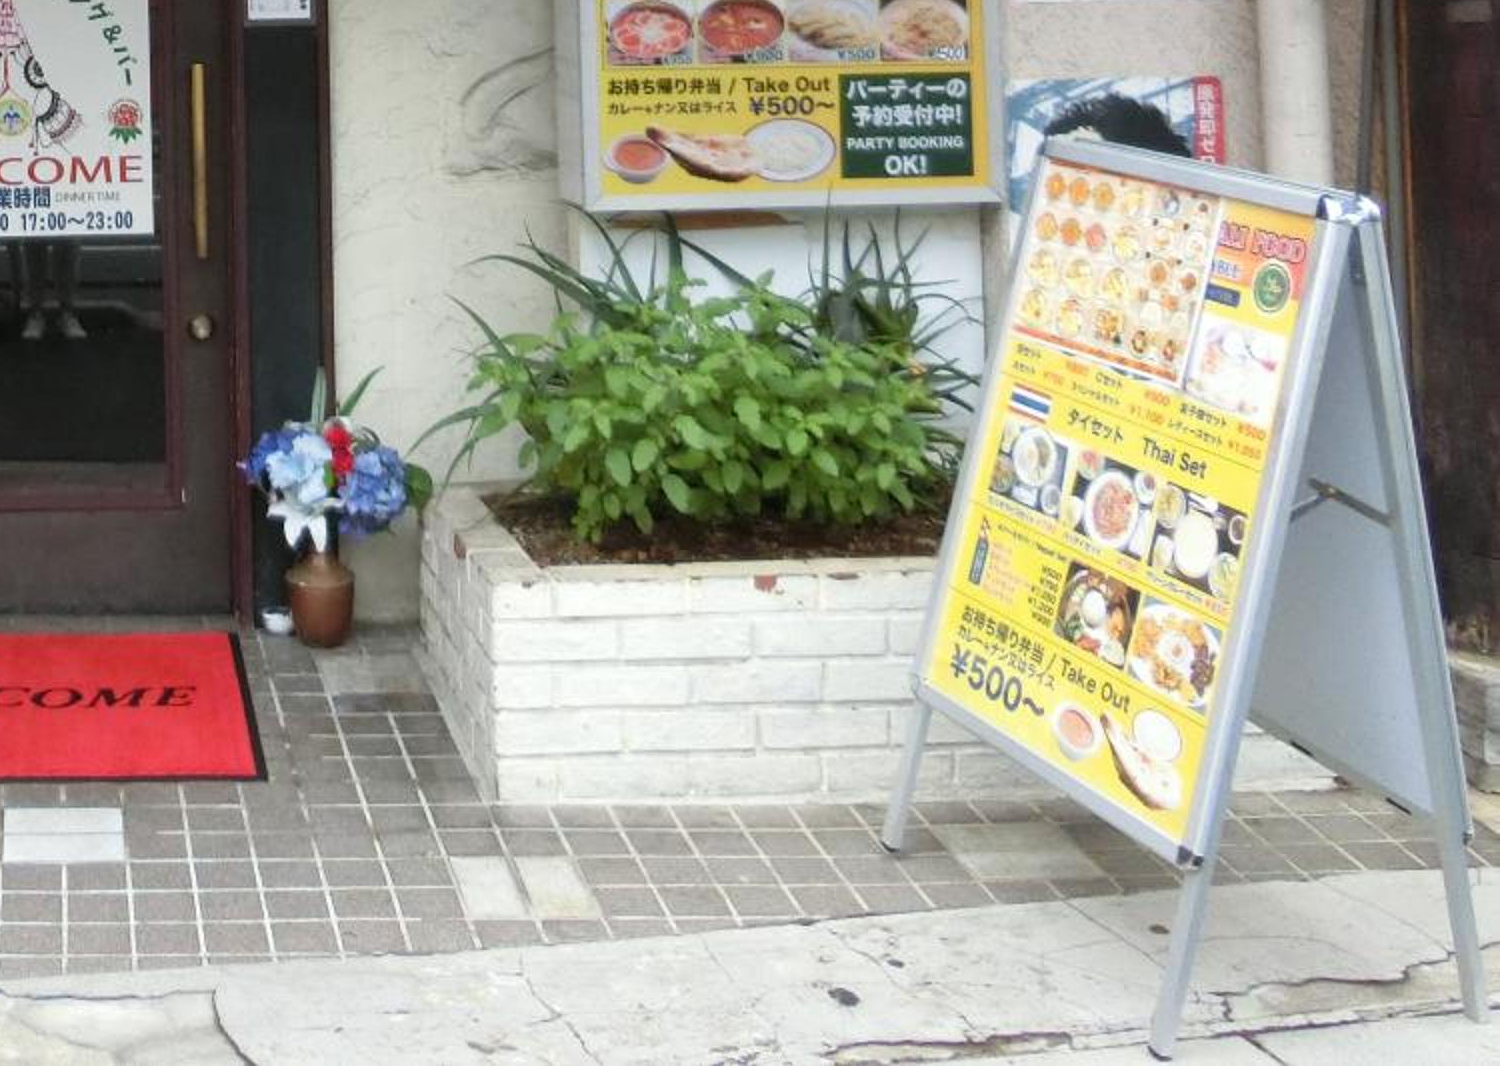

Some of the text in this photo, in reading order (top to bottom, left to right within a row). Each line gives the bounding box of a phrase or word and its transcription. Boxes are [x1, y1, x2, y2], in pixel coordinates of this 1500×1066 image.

[607, 76, 831, 96] お持ち帰り弁当 / Take Out
[847, 78, 966, 98] パーティーの
[851, 103, 964, 126] 予約受付中!
[846, 135, 964, 150] PARTY BOOKING
[884, 154, 928, 175] OK!
[54, 190, 94, 203] DINNER
[95, 190, 121, 202] TIME
[1067, 407, 1208, 480] タイセット Thai Set
[1059, 657, 1098, 695] Take
[1100, 681, 1131, 713] Out
